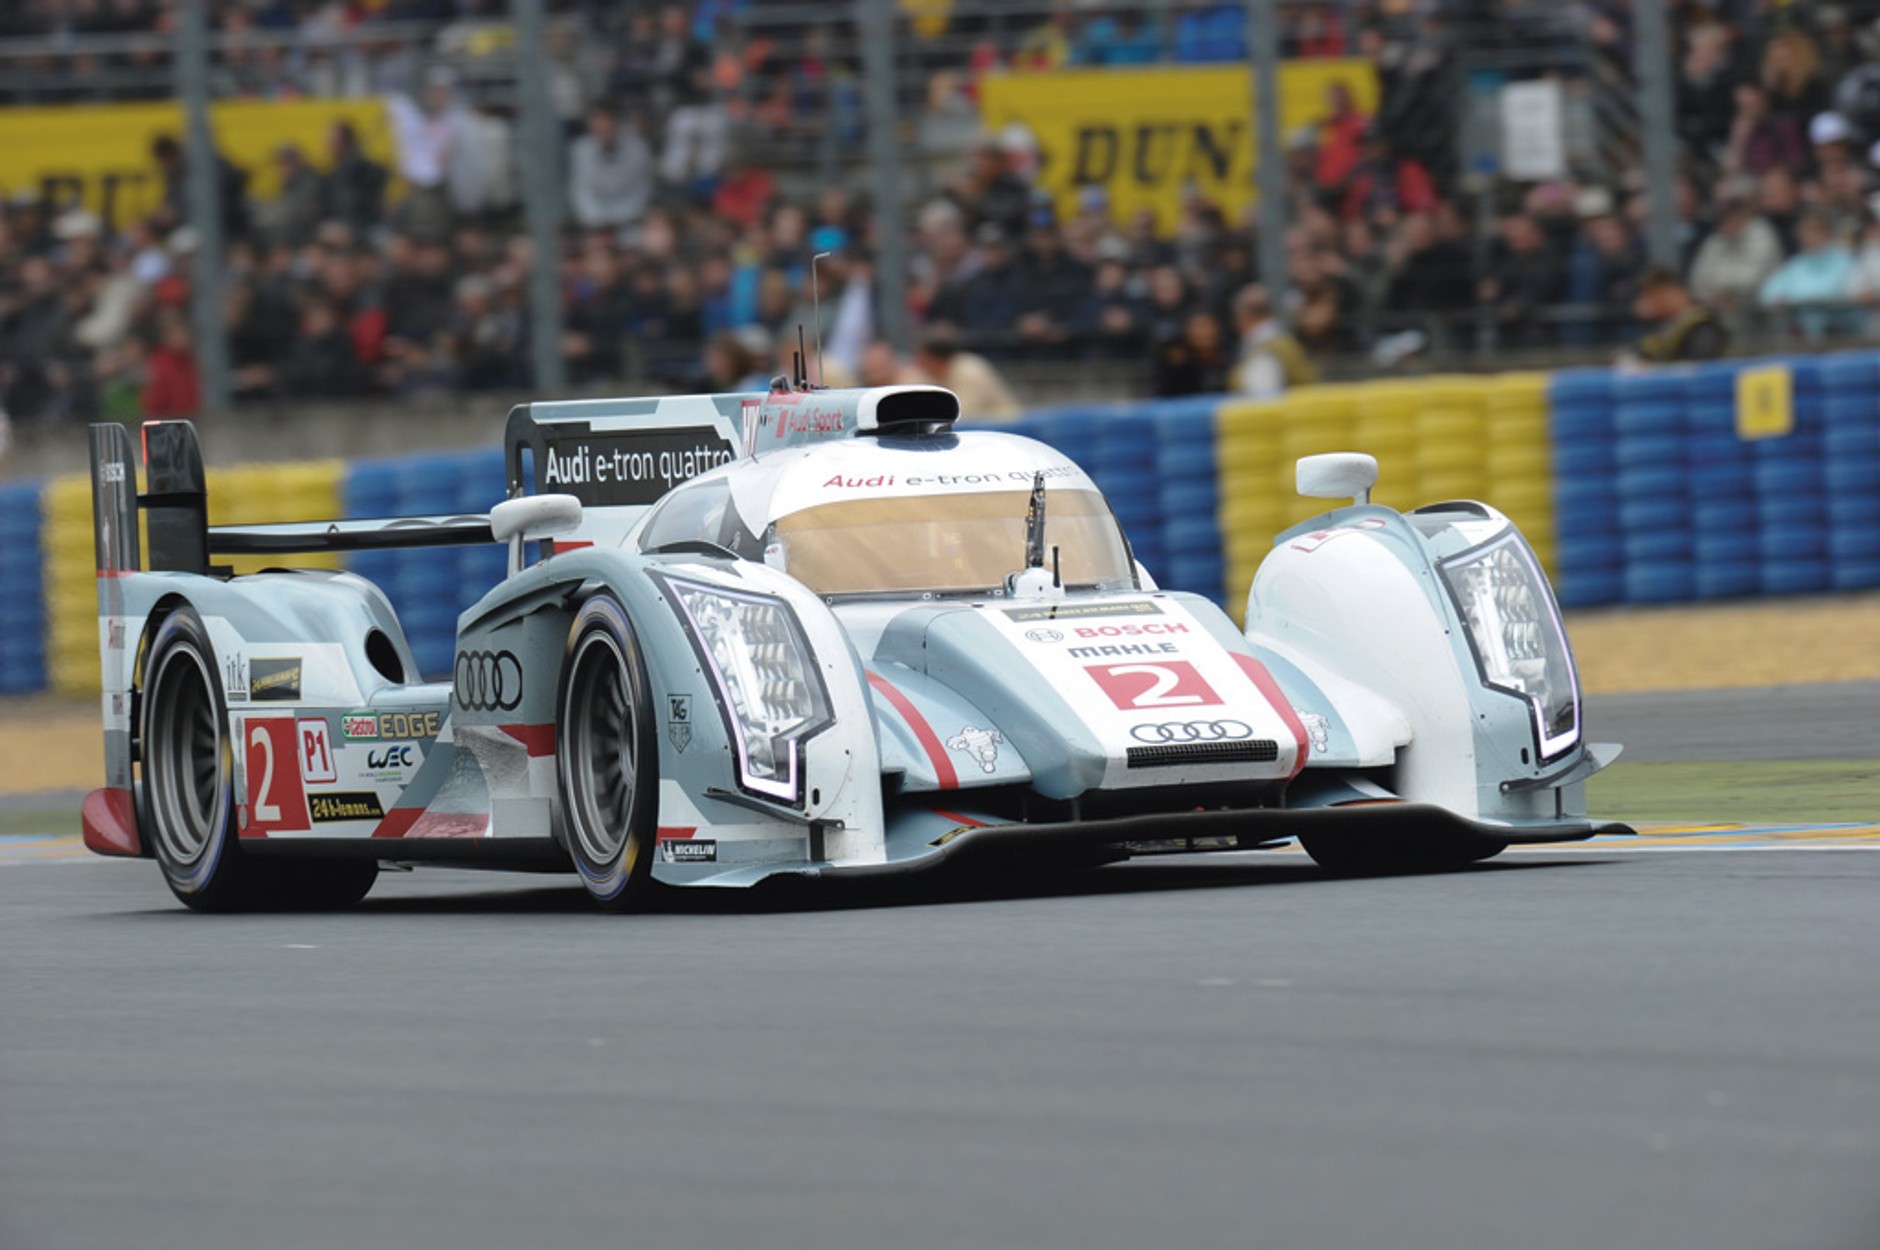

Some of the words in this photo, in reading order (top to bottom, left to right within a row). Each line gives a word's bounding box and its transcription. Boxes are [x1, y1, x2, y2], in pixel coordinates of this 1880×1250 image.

[546, 446, 591, 484] Audi
[595, 448, 655, 482] e-tron
[822, 474, 895, 488] Audi
[906, 473, 1002, 486] e-tron
[1074, 622, 1190, 639] BOSCH
[1067, 642, 1180, 658] MAHLE
[1107, 664, 1204, 707] 2
[380, 711, 442, 738] EDGE
[303, 730, 329, 772] P1
[367, 745, 413, 769] WEC
[251, 725, 282, 822] 2
